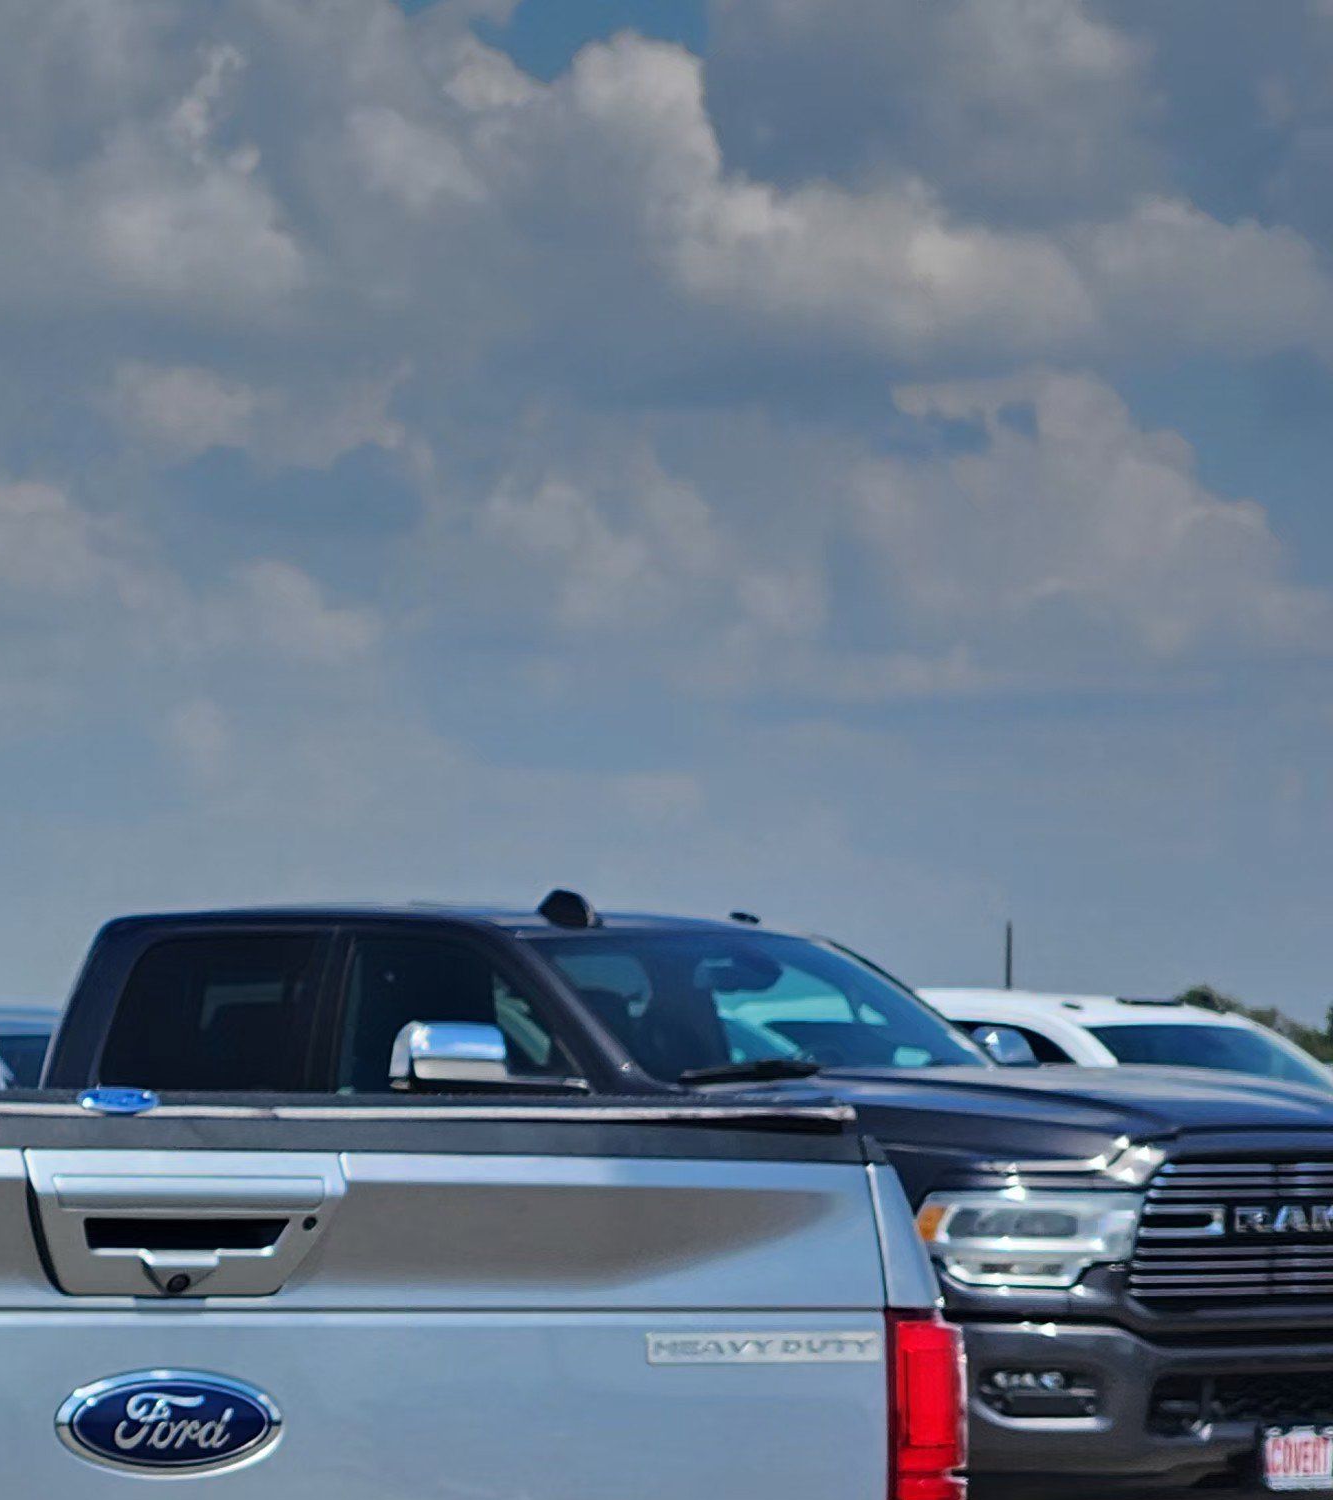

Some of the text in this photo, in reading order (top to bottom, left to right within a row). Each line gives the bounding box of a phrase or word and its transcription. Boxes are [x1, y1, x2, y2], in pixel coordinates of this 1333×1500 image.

[652, 1338, 873, 1356] HEAVY DUTY
[114, 1391, 234, 1450] Ford
[1265, 1436, 1330, 1474] COVERT
